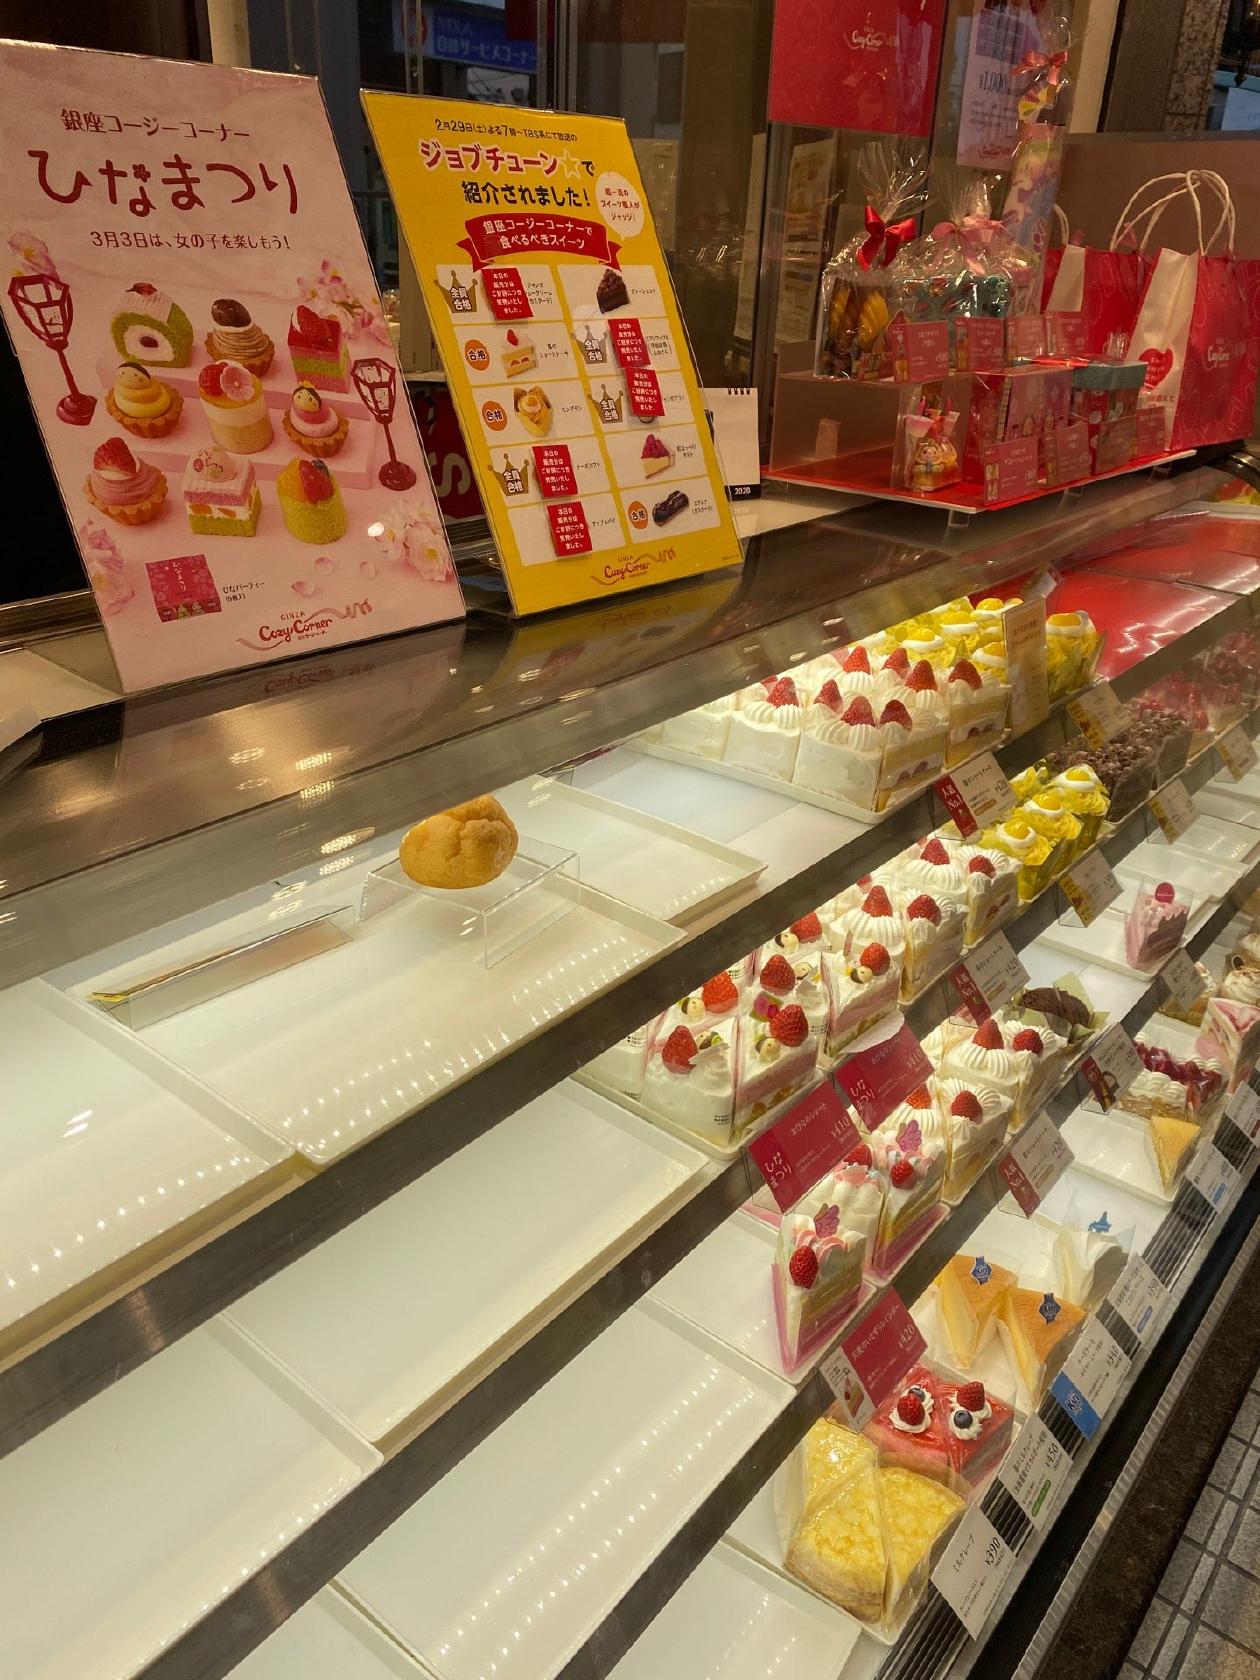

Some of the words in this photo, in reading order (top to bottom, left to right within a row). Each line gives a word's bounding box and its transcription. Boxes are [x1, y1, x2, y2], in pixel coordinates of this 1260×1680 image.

[61, 109, 249, 142] 銀座コージーコーナー
[28, 150, 297, 217] ひなまつり
[450, 287, 469, 299] 全員
[453, 299, 472, 311] 合格
[584, 339, 601, 351] 全員
[468, 349, 486, 361] 合格
[588, 351, 603, 361] 合格
[600, 399, 616, 410] 全員
[485, 410, 504, 421] 合格
[603, 410, 619, 420] 合格
[503, 469, 522, 481] 全員
[507, 481, 525, 493] 合格
[734, 487, 751, 495] 2020
[280, 611, 306, 621] GINZA
[258, 625, 294, 642] Cozy
[292, 619, 333, 634] Corner
[763, 1150, 785, 1175] ひな
[768, 1161, 793, 1190] まつり
[895, 1320, 916, 1350] ¥420
[1042, 1440, 1059, 1469] ¥450
[951, 1531, 977, 1574] ミルクレープ
[981, 1534, 1003, 1568] ¥390
